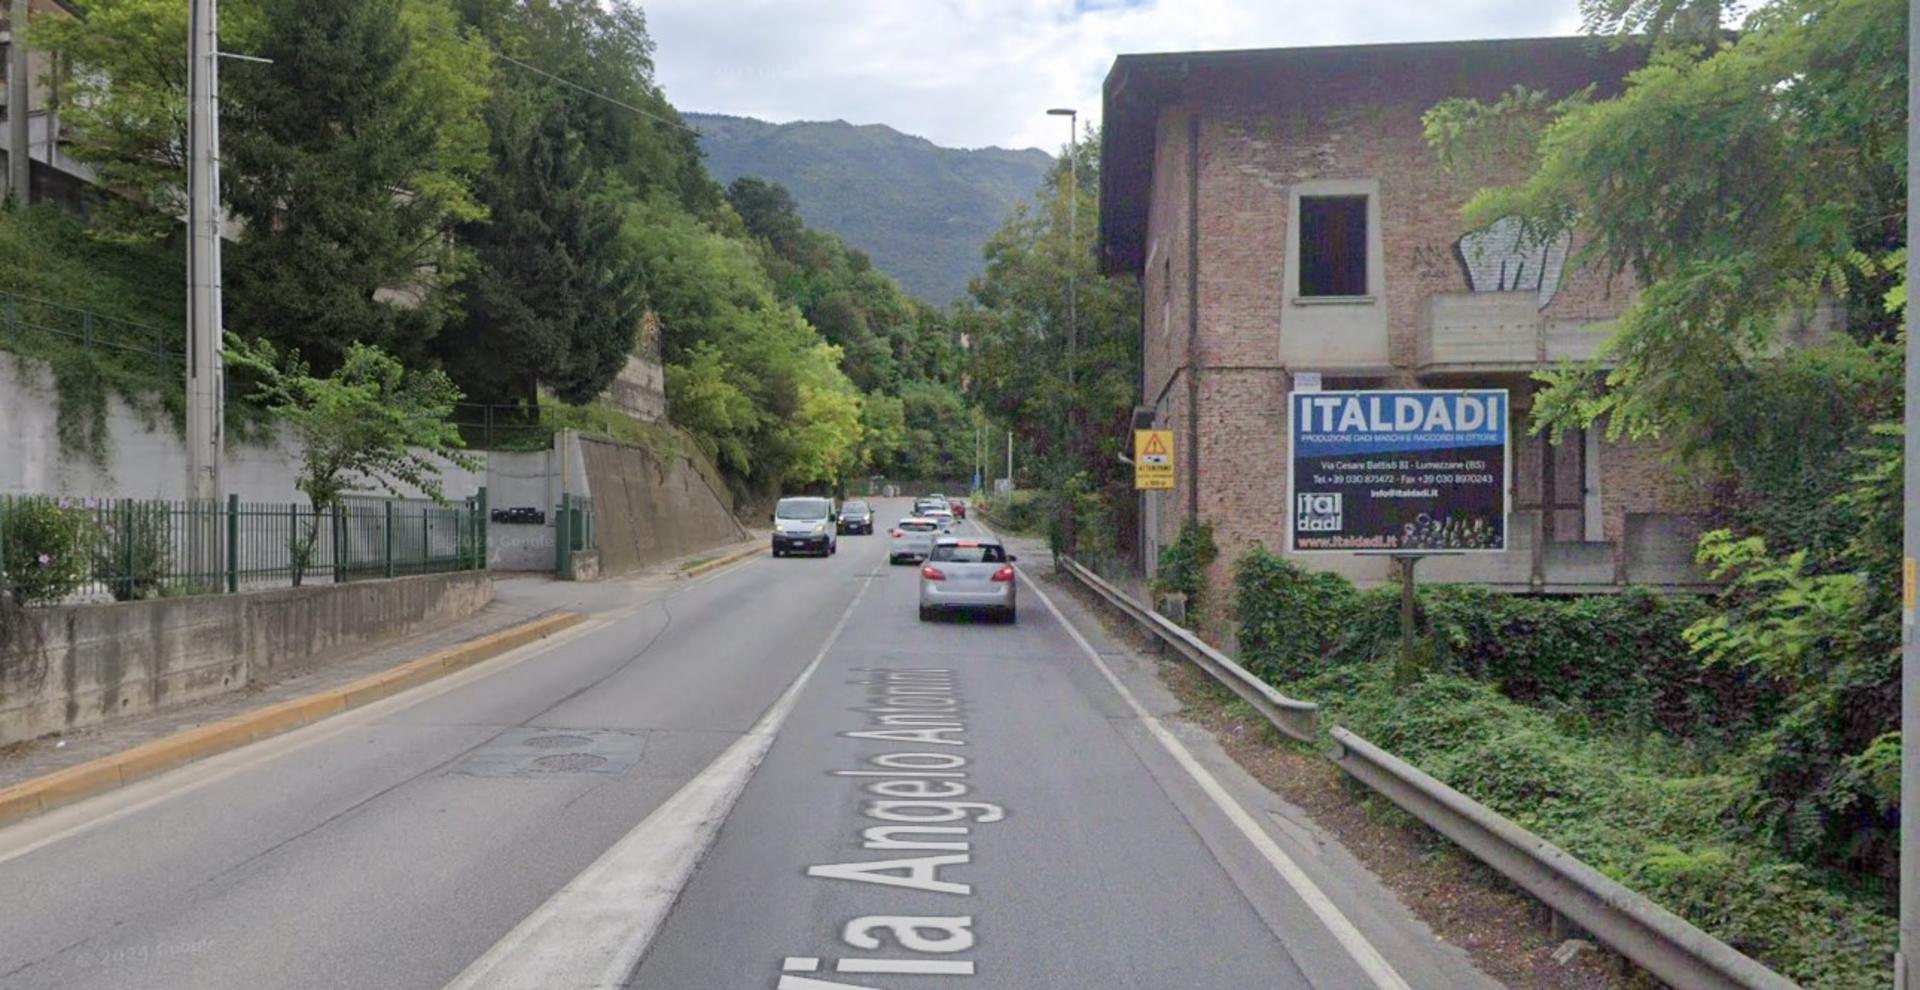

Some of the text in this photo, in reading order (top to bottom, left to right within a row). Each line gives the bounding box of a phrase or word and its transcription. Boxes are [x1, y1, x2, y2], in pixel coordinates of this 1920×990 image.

[1301, 397, 1498, 432] ITALDADI
[1301, 434, 1351, 442] PRODUZIONE
[1321, 461, 1335, 469] Via
[1336, 461, 1365, 469] Cesare
[1415, 461, 1464, 469] Lumezzane
[1465, 460, 1486, 470] (BS)
[1345, 474, 1363, 483] 030
[1400, 474, 1416, 483] Fax
[1418, 474, 1433, 483] +39
[1435, 474, 1453, 483] 030
[1370, 489, 1439, 498] info@italdadi.it
[1298, 515, 1341, 531] dadi
[1298, 535, 1398, 548] www.italdadi.it
